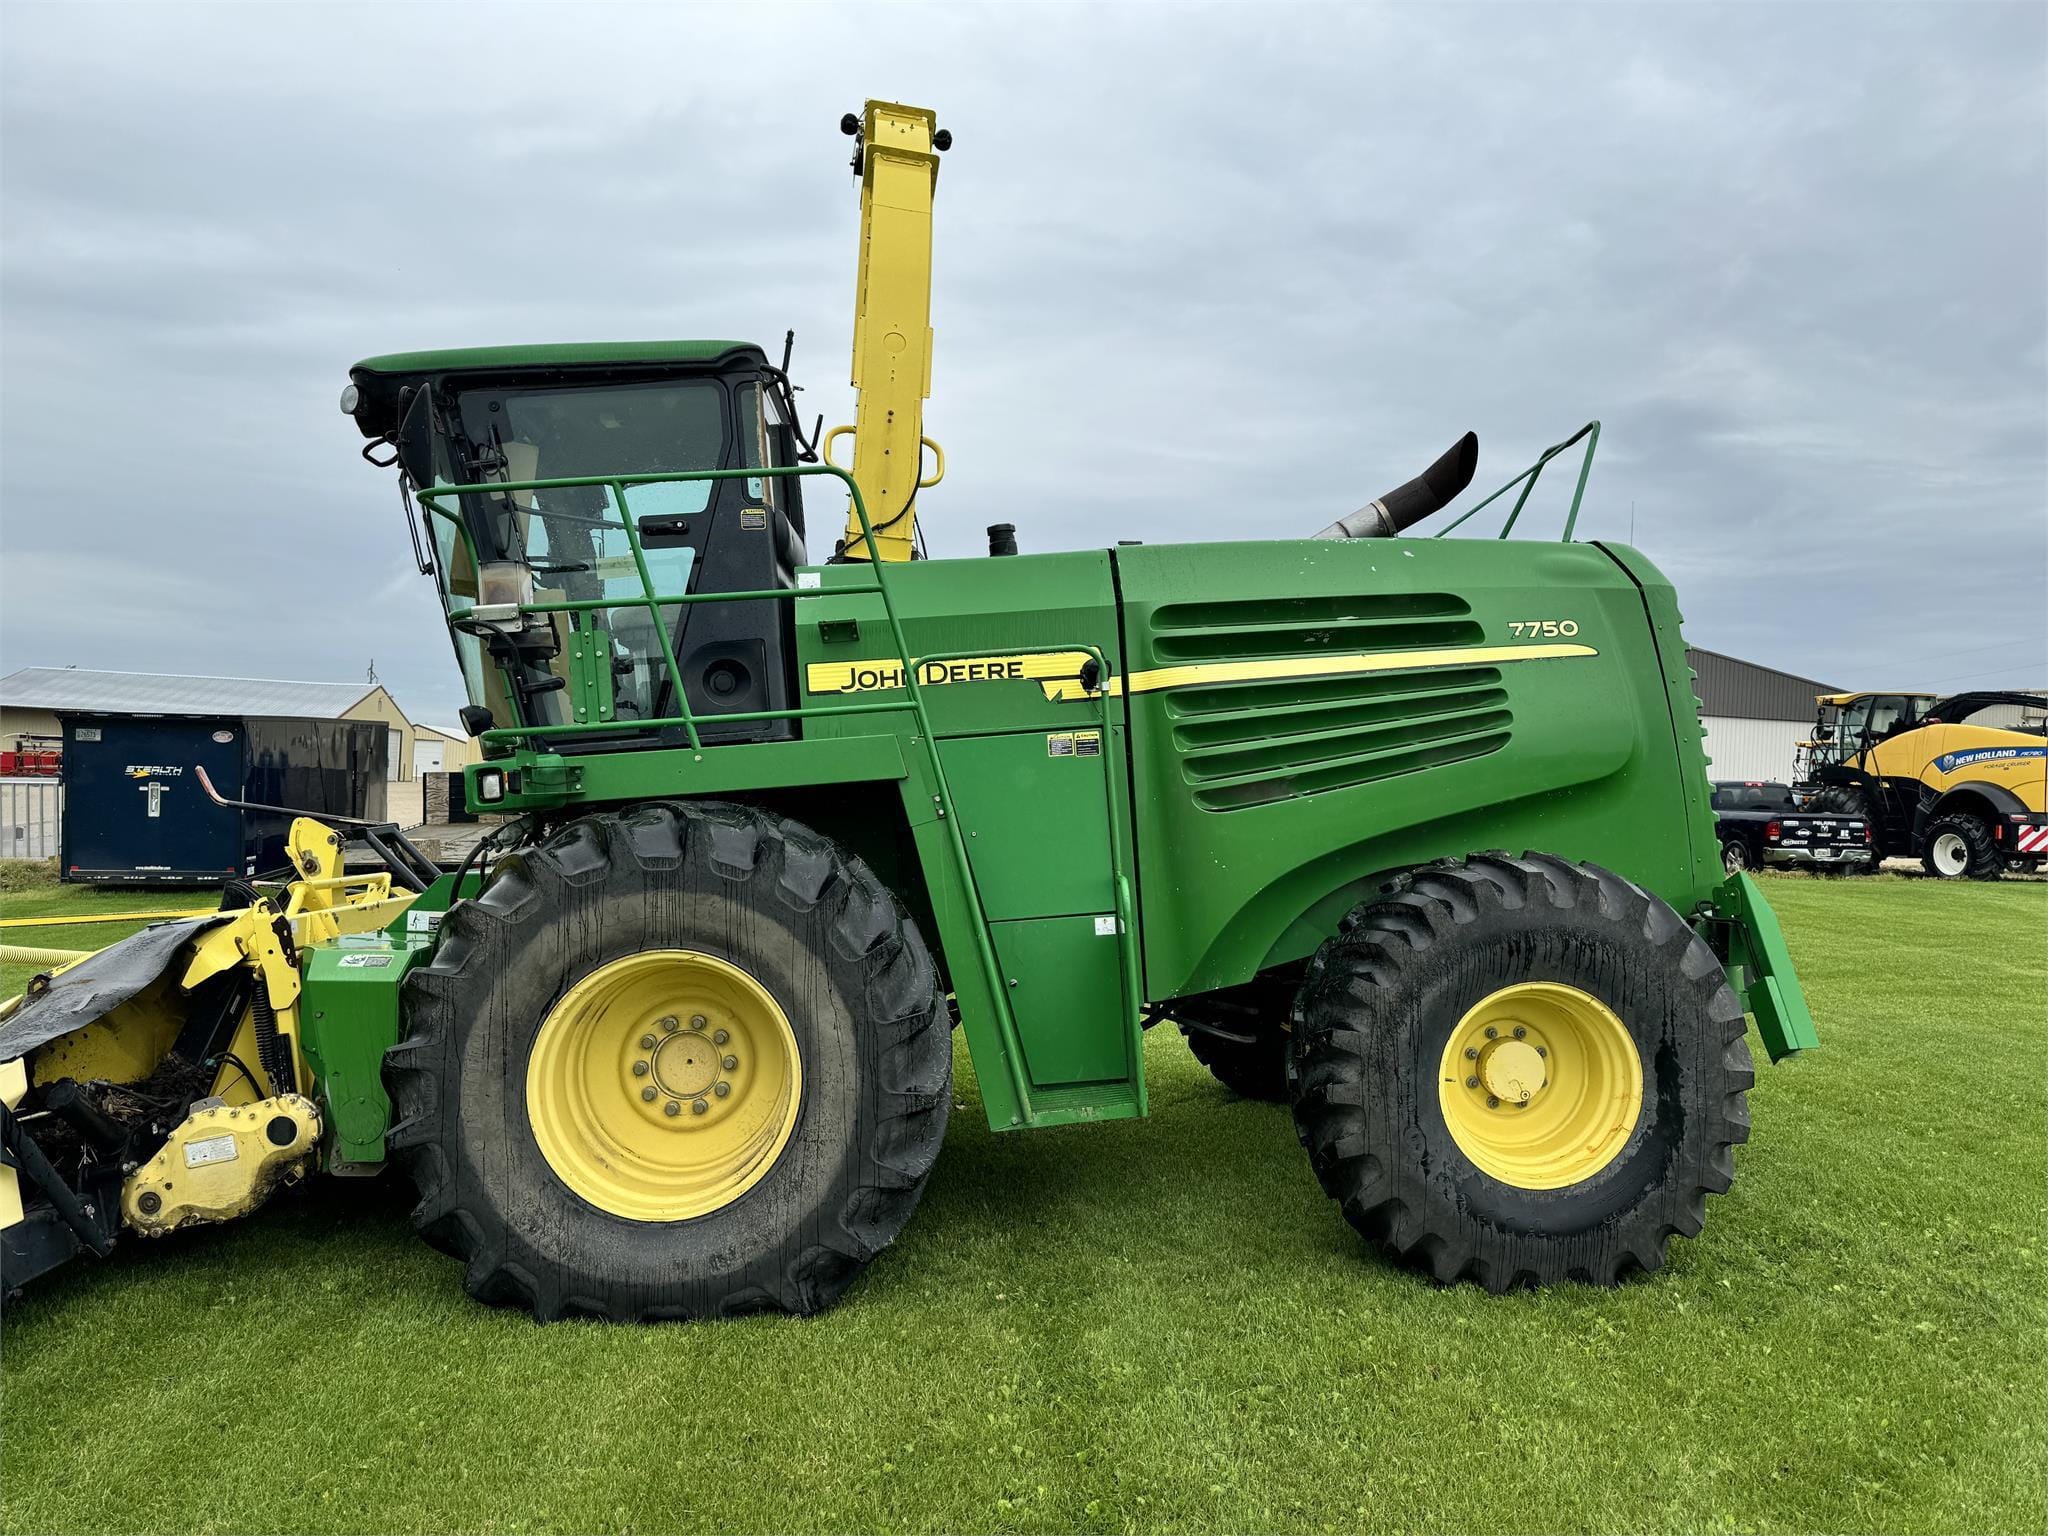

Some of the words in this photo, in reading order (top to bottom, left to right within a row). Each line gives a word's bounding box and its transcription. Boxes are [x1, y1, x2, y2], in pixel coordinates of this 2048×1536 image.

[1507, 619, 1579, 639] 7750
[926, 662, 1024, 684] DEERE
[1955, 754, 1974, 766] NEW
[1975, 749, 2017, 761] HOLLAND
[125, 765, 183, 775] STEALTH
